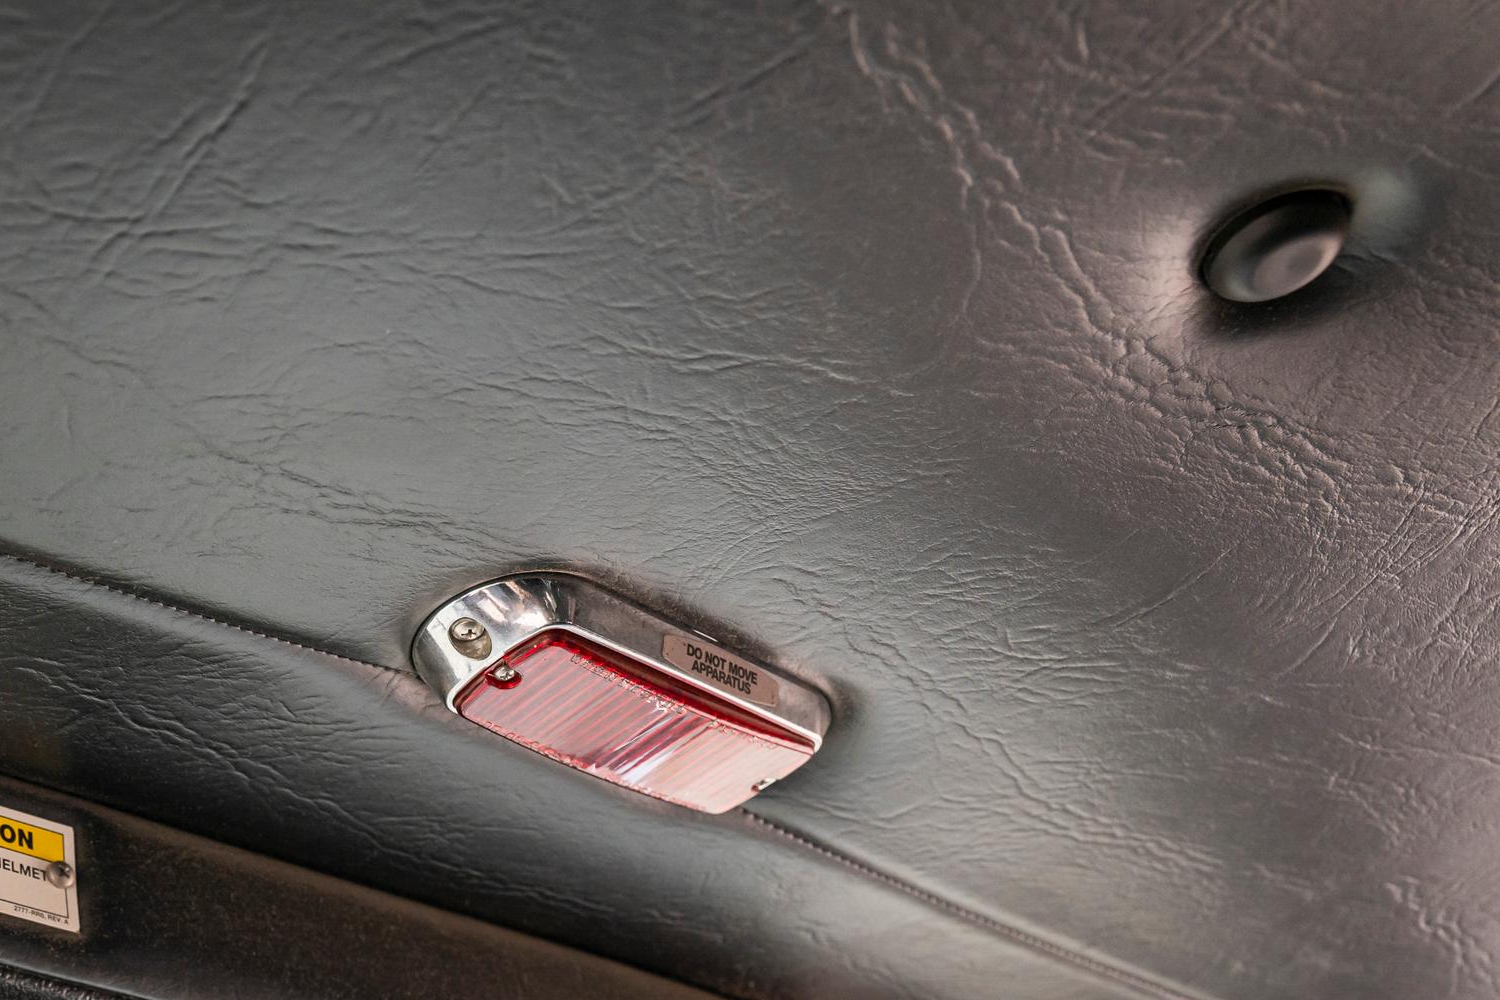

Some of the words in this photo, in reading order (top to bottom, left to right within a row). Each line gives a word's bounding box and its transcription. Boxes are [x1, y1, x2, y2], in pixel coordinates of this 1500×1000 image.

[686, 643, 702, 659] DO
[705, 651, 727, 668] NOT
[728, 662, 758, 685] MOVE
[691, 659, 752, 695] APPARATUS
